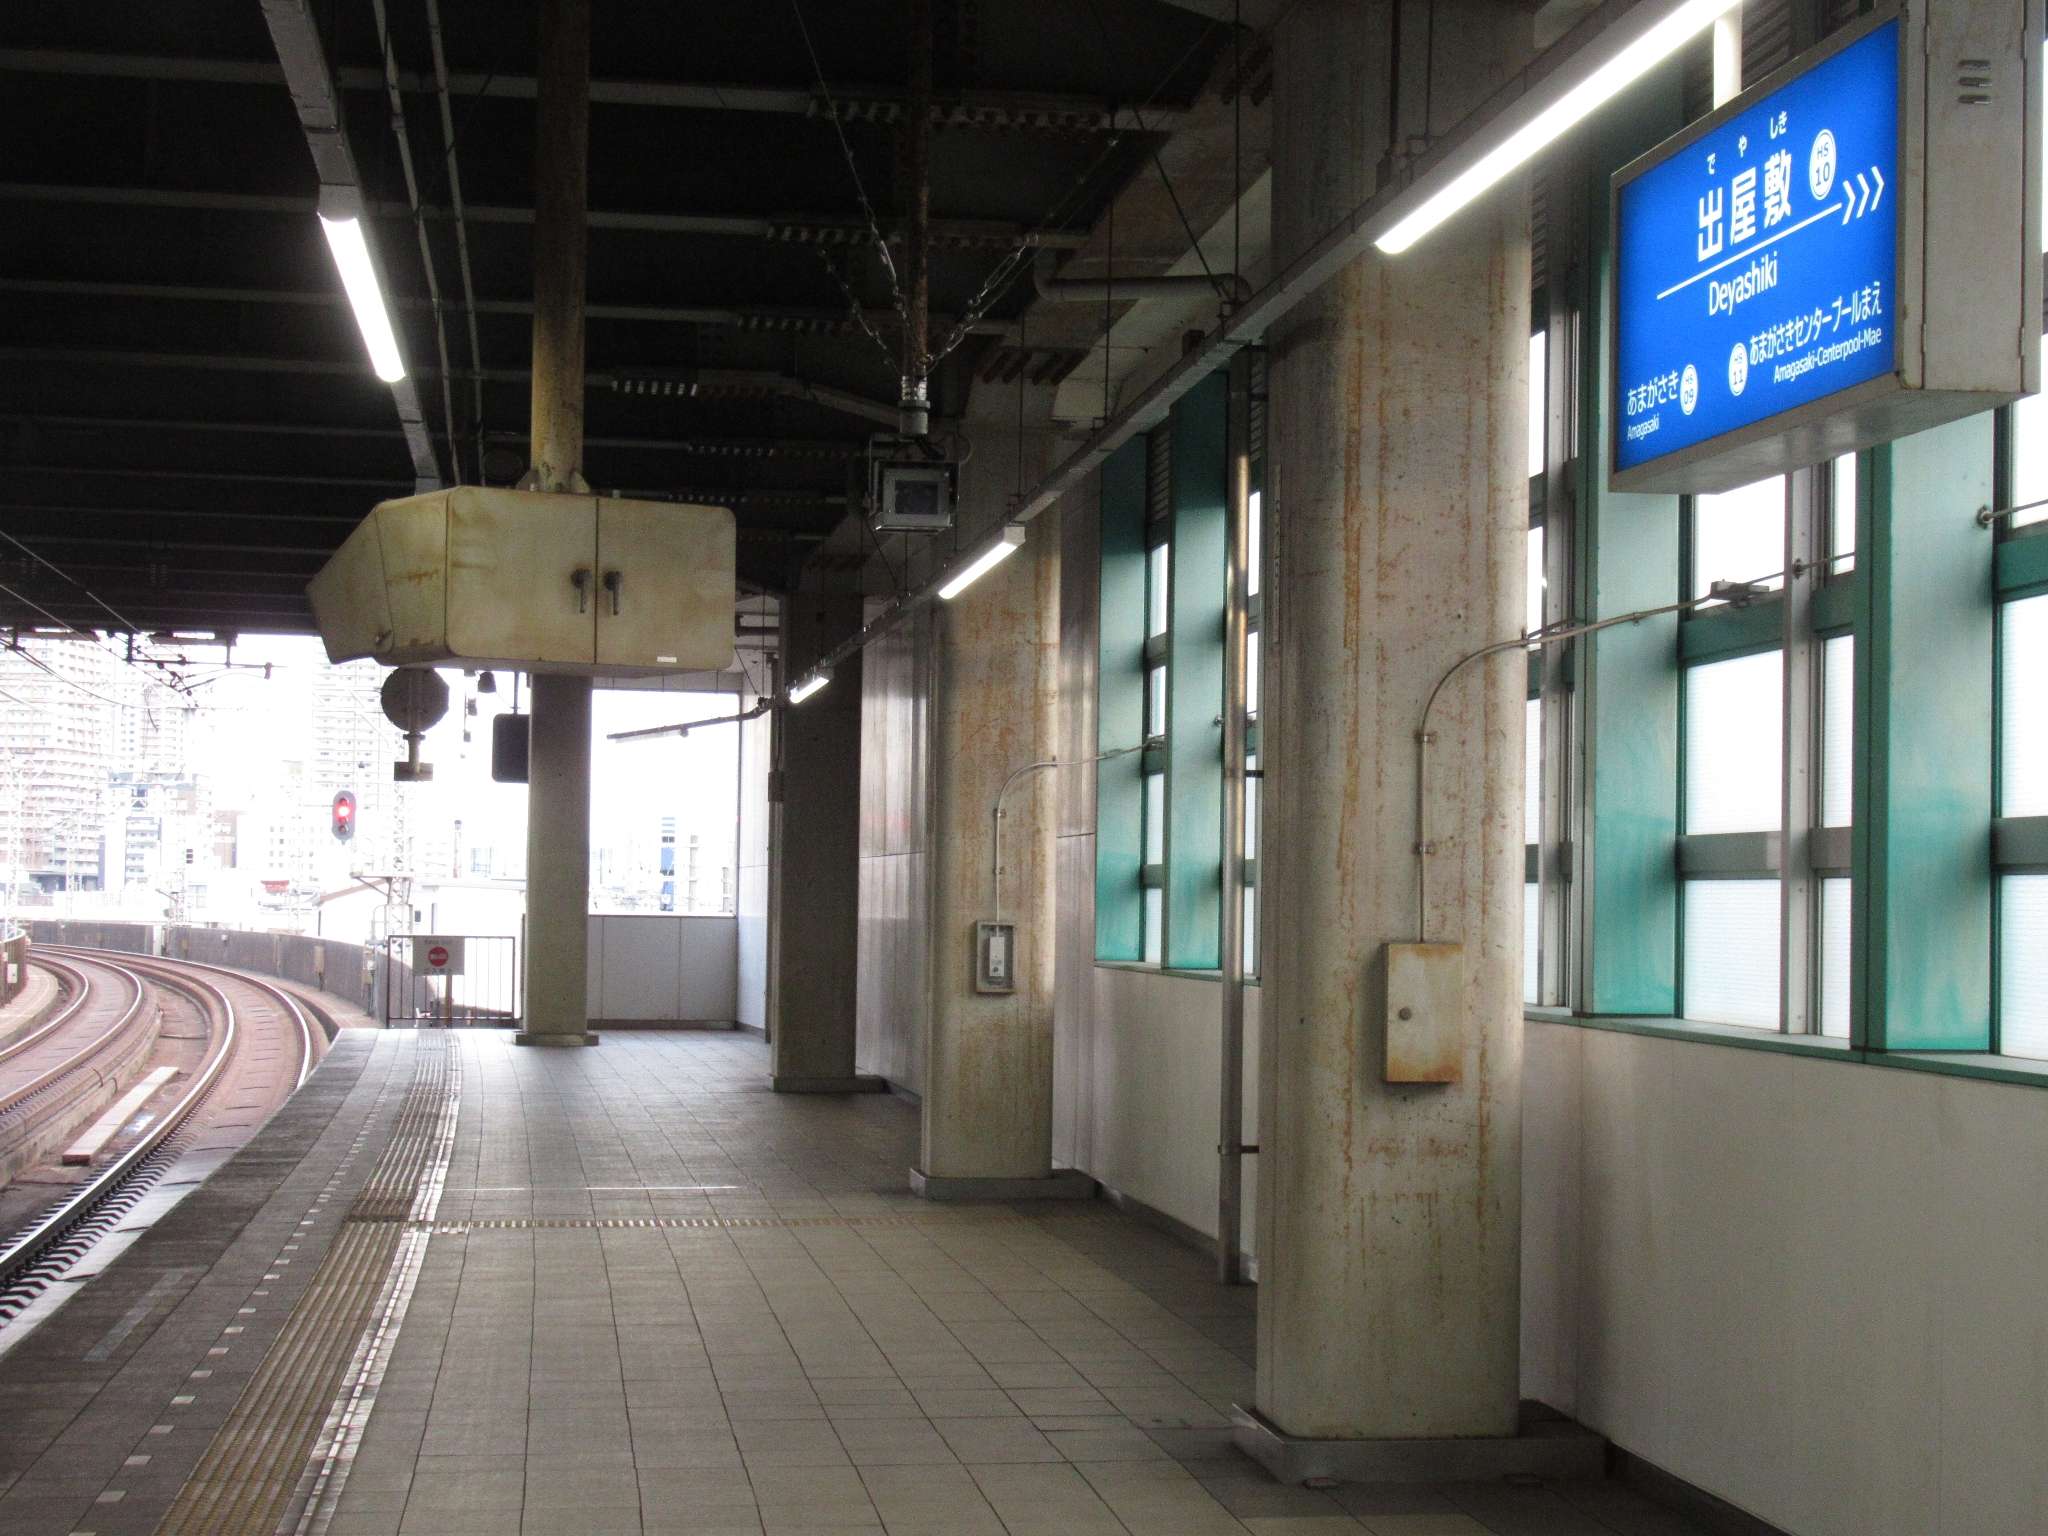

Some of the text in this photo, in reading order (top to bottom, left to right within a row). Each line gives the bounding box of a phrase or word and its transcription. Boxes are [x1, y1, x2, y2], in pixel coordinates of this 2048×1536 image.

[1816, 141, 1829, 159] HS
[1815, 162, 1830, 187] 10
[1698, 149, 1792, 262] 出屋敷
[1709, 250, 1778, 316] Deyashiki
[1750, 281, 1882, 366] あまがさきセンタープールまえ
[1732, 369, 1744, 386] 11
[1774, 327, 1882, 384] Amagasaki-Centerpool-Mae
[1627, 369, 1679, 416] あまがさき
[1627, 412, 1660, 441] Amagasaki
